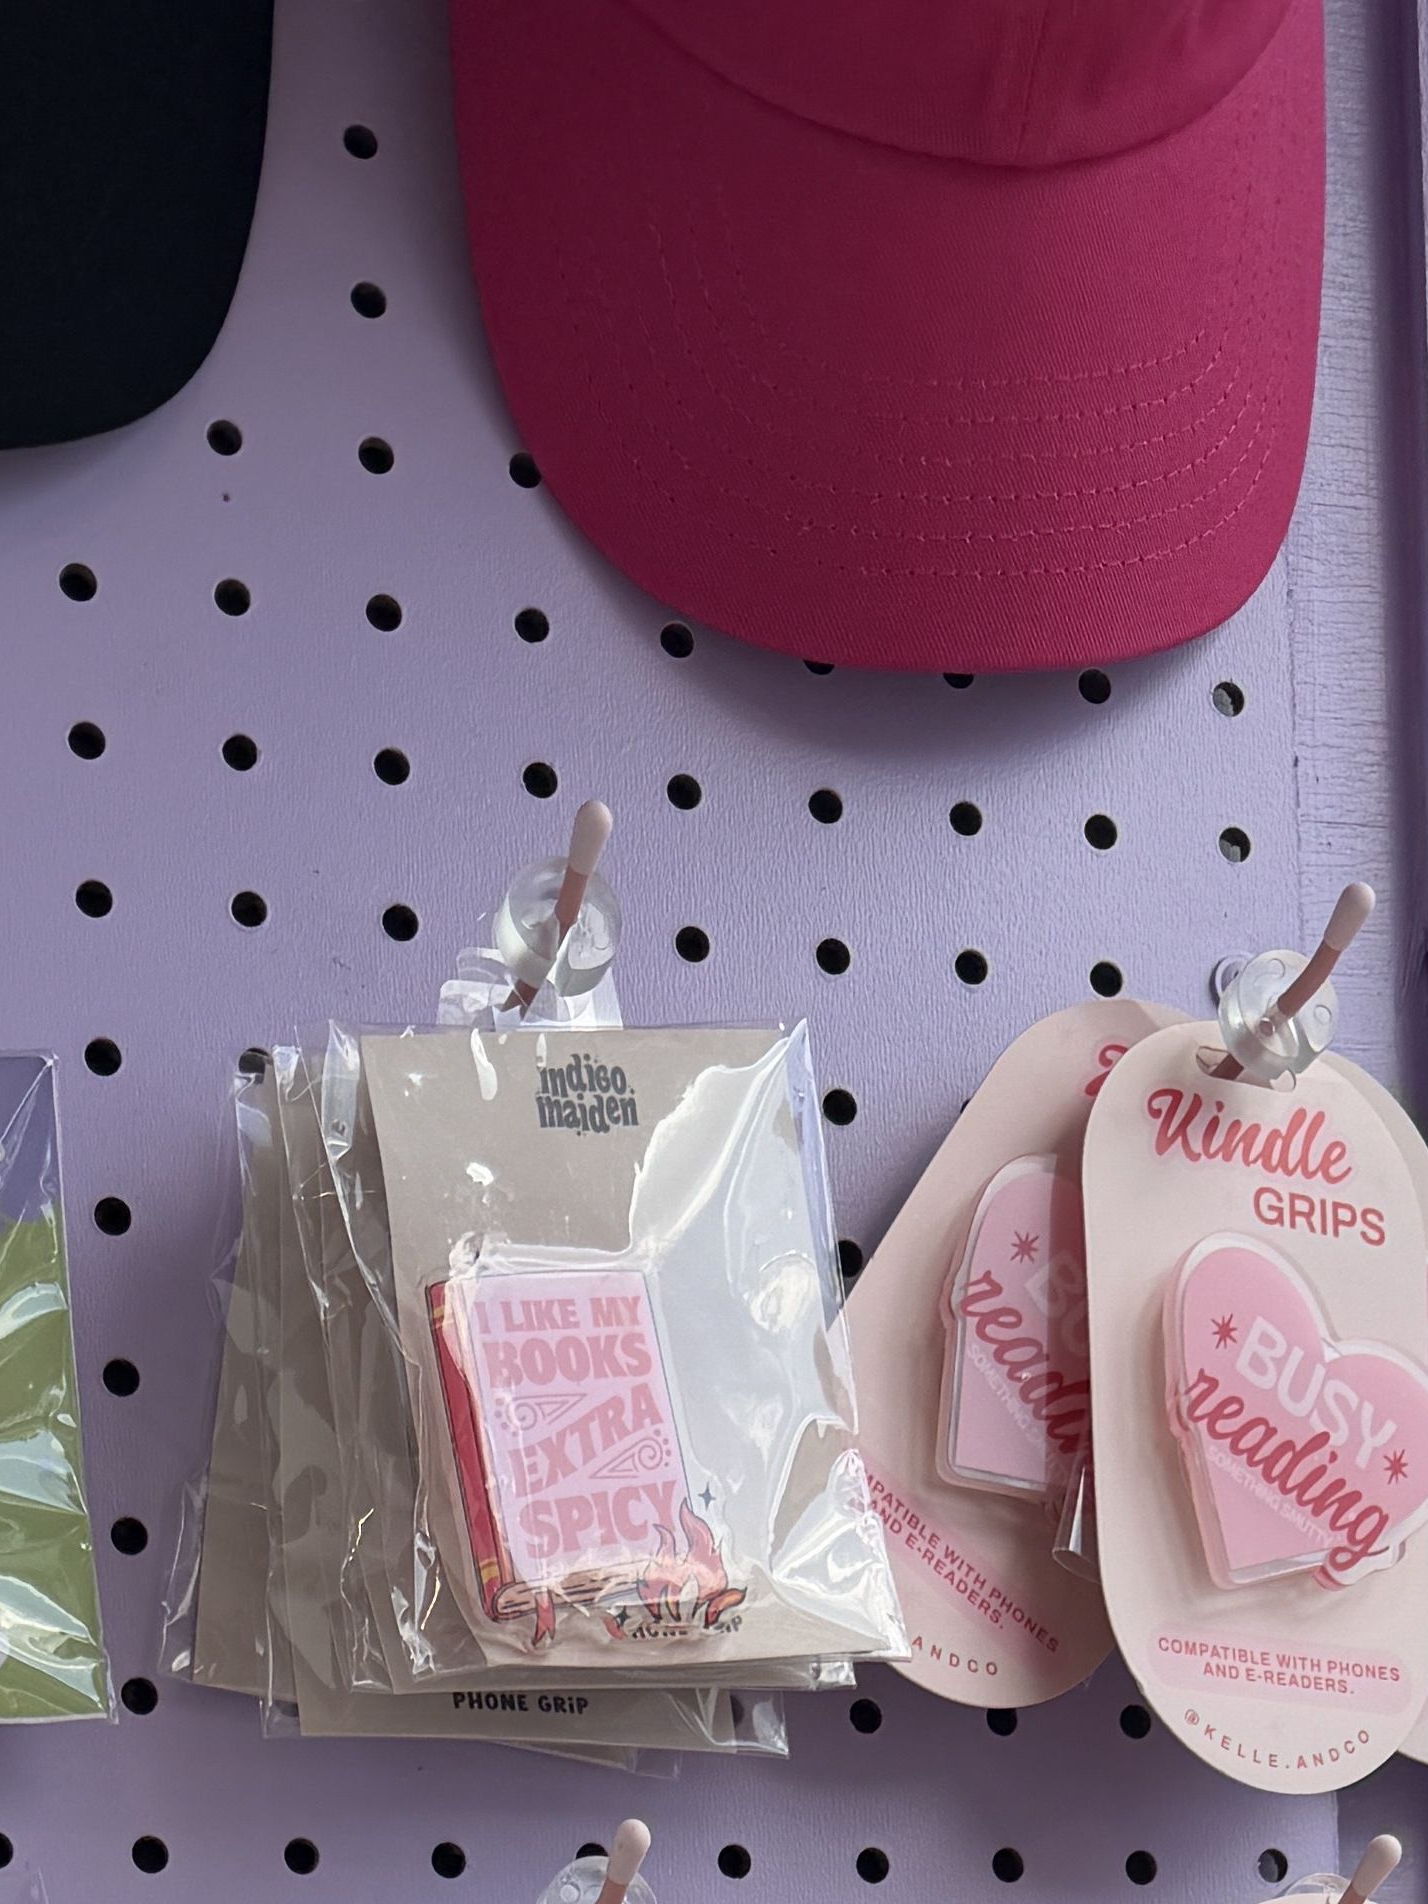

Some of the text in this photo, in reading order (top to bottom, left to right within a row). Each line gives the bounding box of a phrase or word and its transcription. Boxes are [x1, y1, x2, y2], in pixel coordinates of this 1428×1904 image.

[536, 1093, 639, 1134] maiden
[1148, 1086, 1353, 1185] Kindle
[1253, 1187, 1387, 1246] GRIPS
[475, 1296, 641, 1334] I LIKE MY
[482, 1333, 653, 1389] BOOKS
[1236, 1316, 1397, 1470] BUSY
[507, 1383, 664, 1498] EXTRA
[1185, 1368, 1389, 1572] reading
[518, 1480, 677, 1560] SPICY
[943, 1545, 988, 1591] WITH
[988, 1587, 1060, 1654] PHONES
[1158, 1637, 1400, 1682] COMPATIBLE WITH PHONES
[1203, 1662, 1355, 1694] AND E-READERS.
[452, 1691, 529, 1712] PHONE
